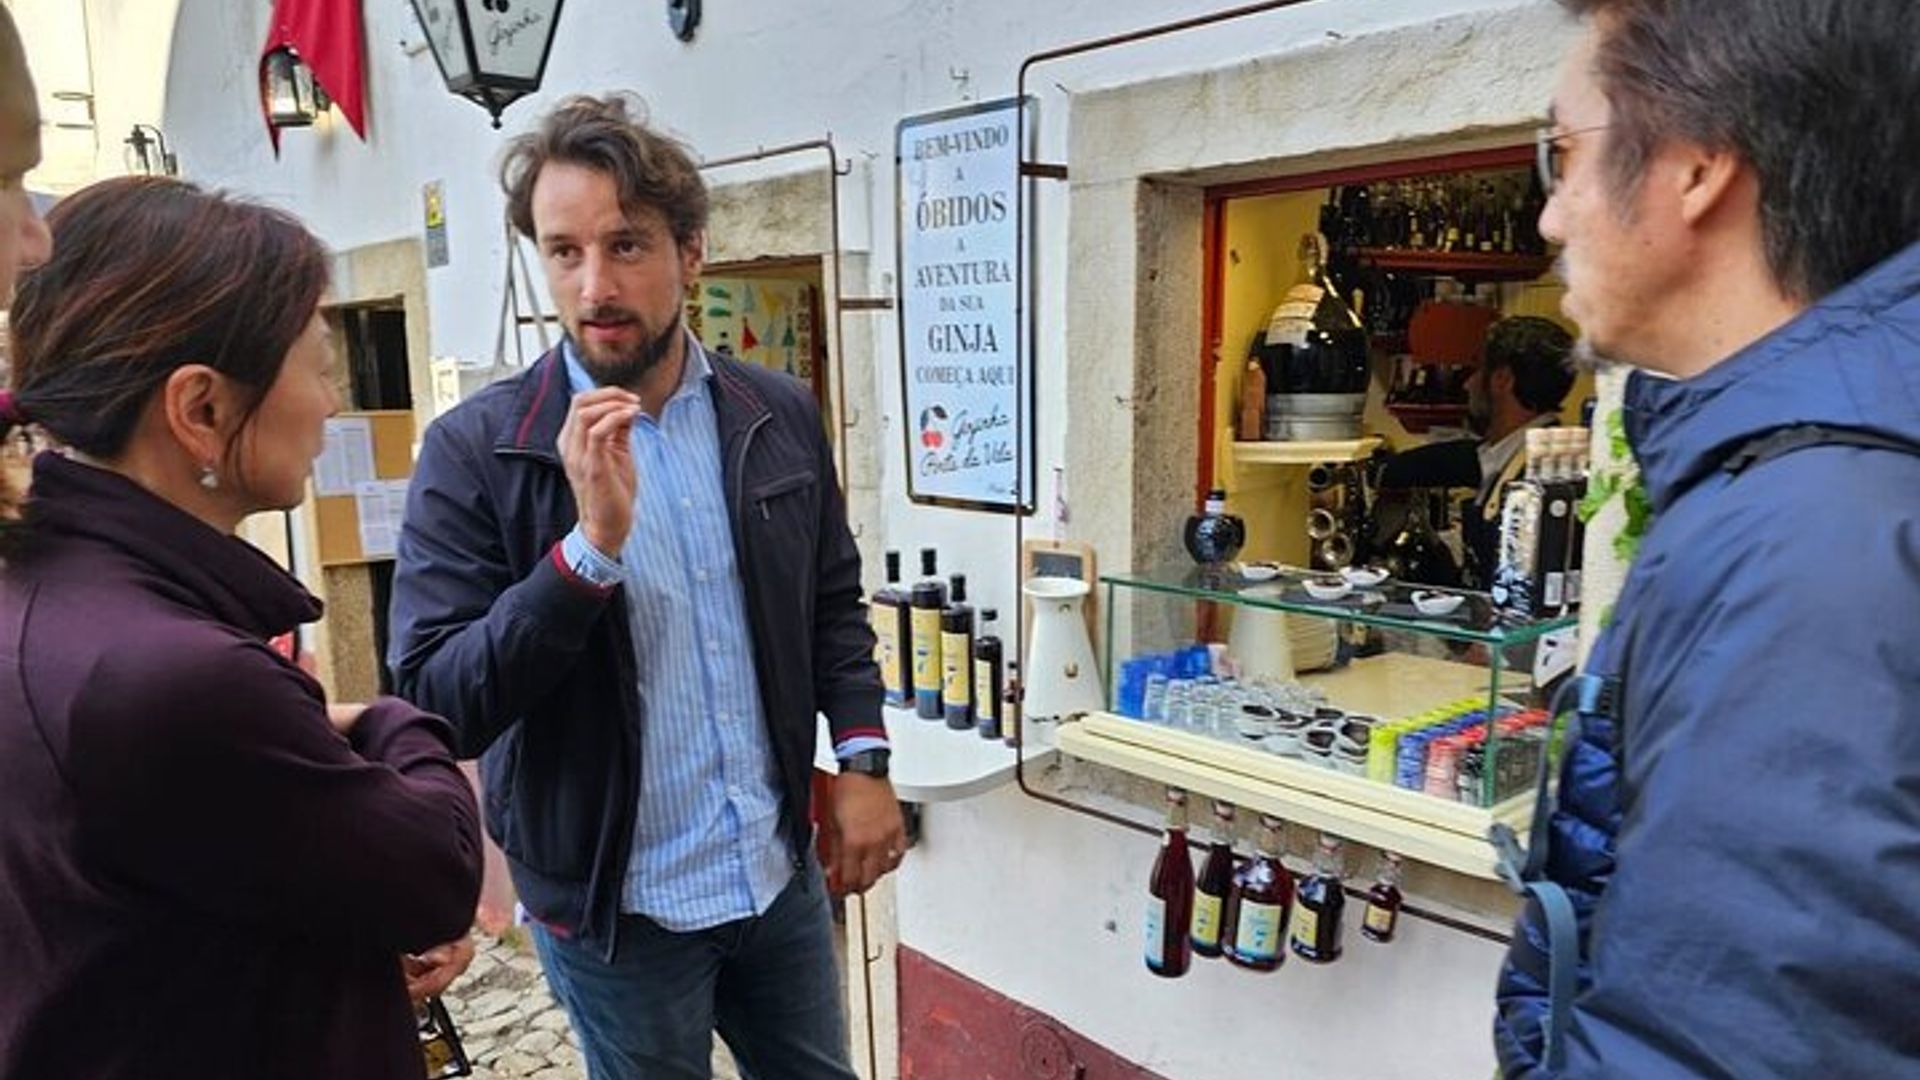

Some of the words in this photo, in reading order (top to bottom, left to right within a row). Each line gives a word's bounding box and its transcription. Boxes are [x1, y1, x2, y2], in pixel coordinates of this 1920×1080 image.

[914, 125, 1010, 160] BEM-VINDO
[955, 167, 965, 181] A
[917, 190, 1008, 231] ÓBIDOS
[956, 237, 965, 251] A
[914, 259, 1012, 288] AVENTURA
[939, 297, 956, 312] DA
[959, 294, 985, 311] SUA
[927, 323, 999, 354] GINJA
[914, 366, 973, 389] COMEÇA
[976, 365, 1015, 387] AQUI
